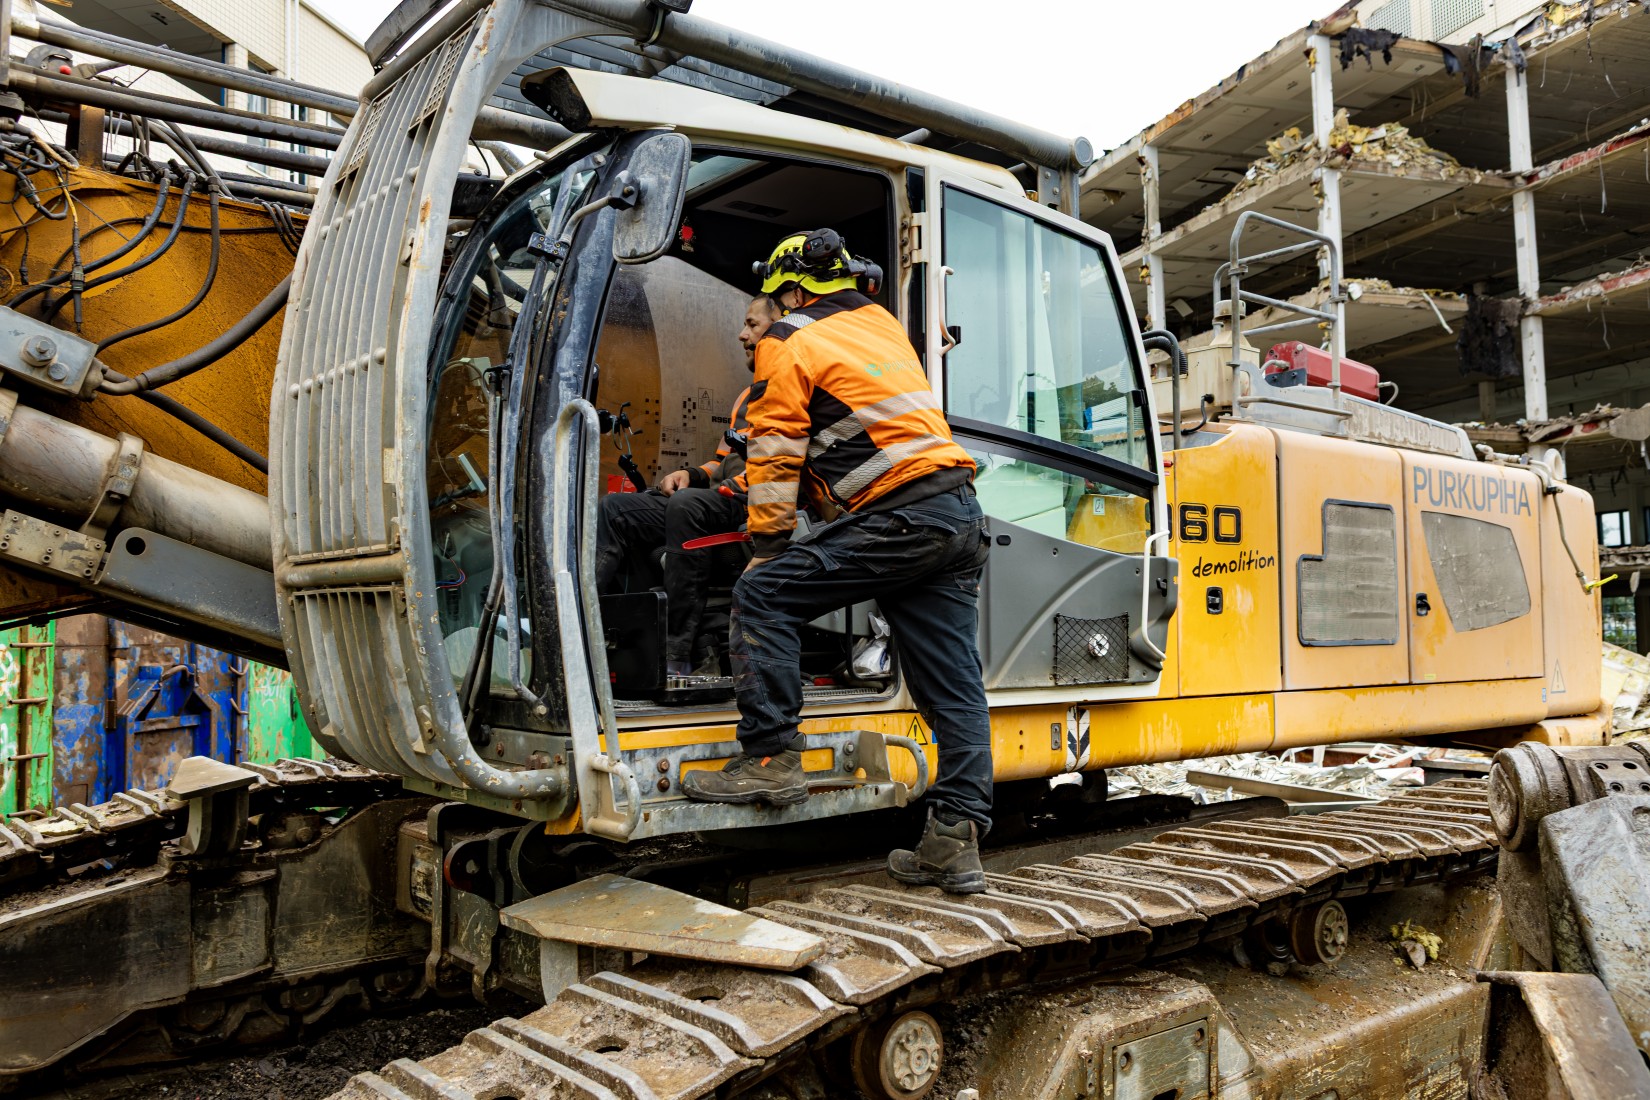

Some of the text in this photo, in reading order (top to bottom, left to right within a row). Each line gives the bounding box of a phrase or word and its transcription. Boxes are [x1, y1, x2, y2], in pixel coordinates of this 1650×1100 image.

[1413, 465, 1532, 517] PURKUPIHA
[1167, 502, 1242, 545] 60
[1191, 549, 1275, 578] demolition
